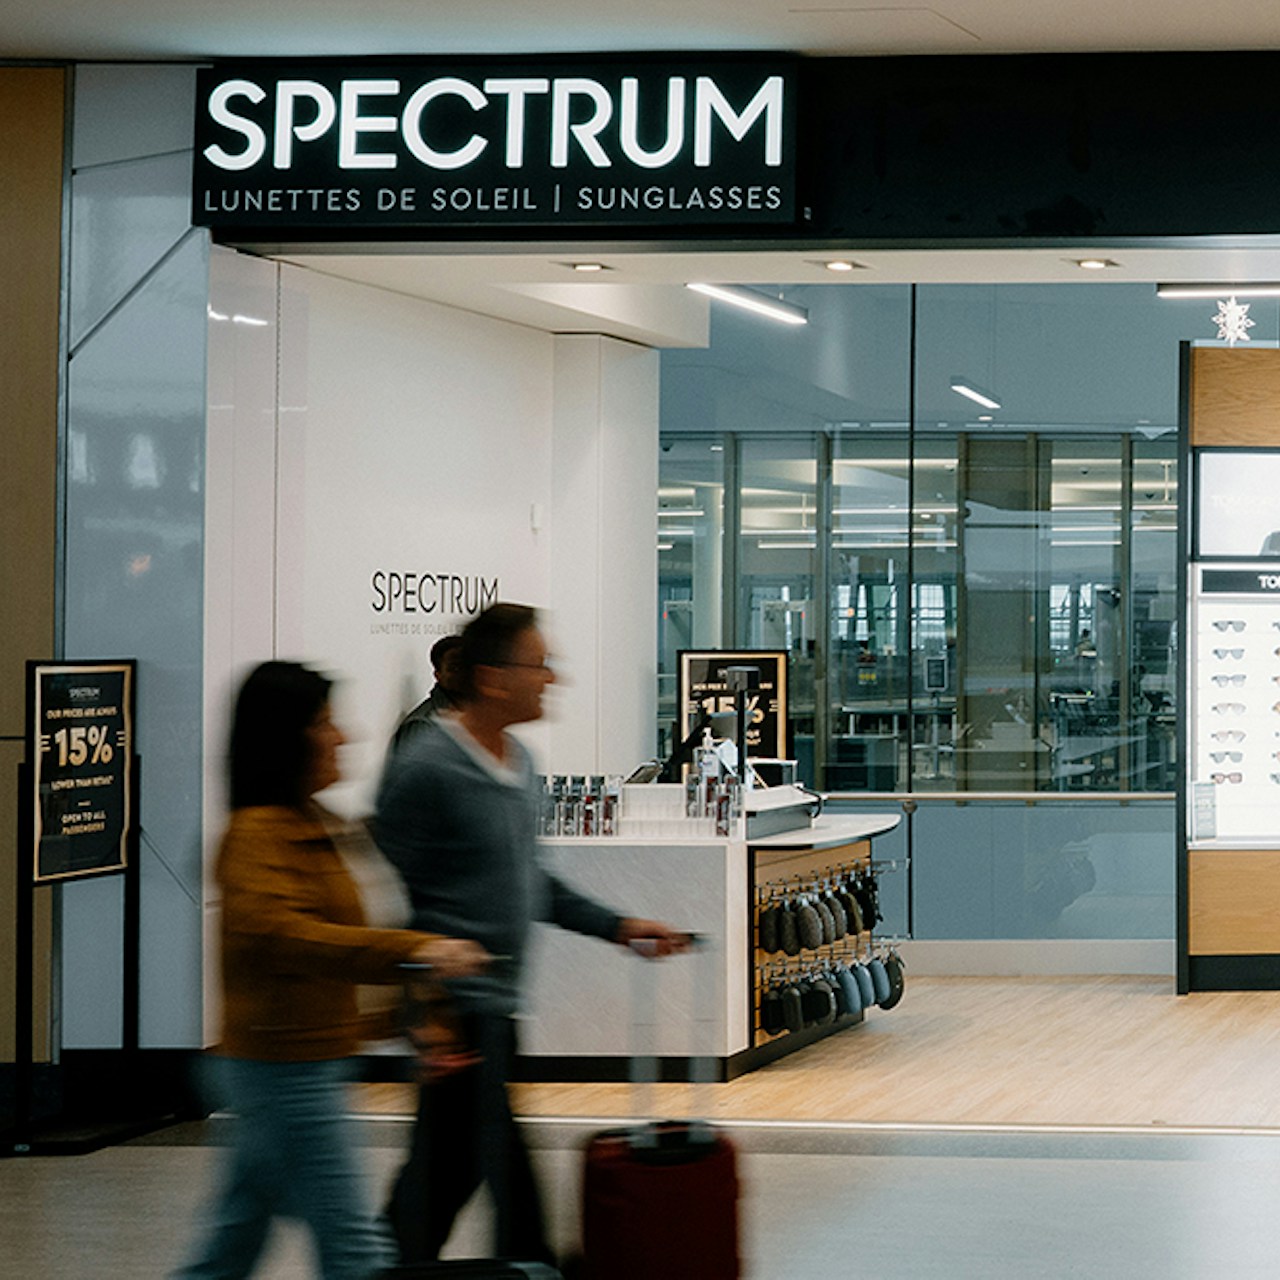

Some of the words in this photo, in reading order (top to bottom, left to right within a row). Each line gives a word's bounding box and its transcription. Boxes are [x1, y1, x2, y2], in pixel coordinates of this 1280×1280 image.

[203, 76, 784, 170] SPECTRUM
[204, 188, 361, 211] LUNETTES
[378, 188, 417, 210] DE
[431, 187, 538, 210] SOLEIL
[577, 185, 783, 210] SUNGLASSES
[372, 571, 498, 614] SPECTRUM
[54, 725, 114, 767] 15%
